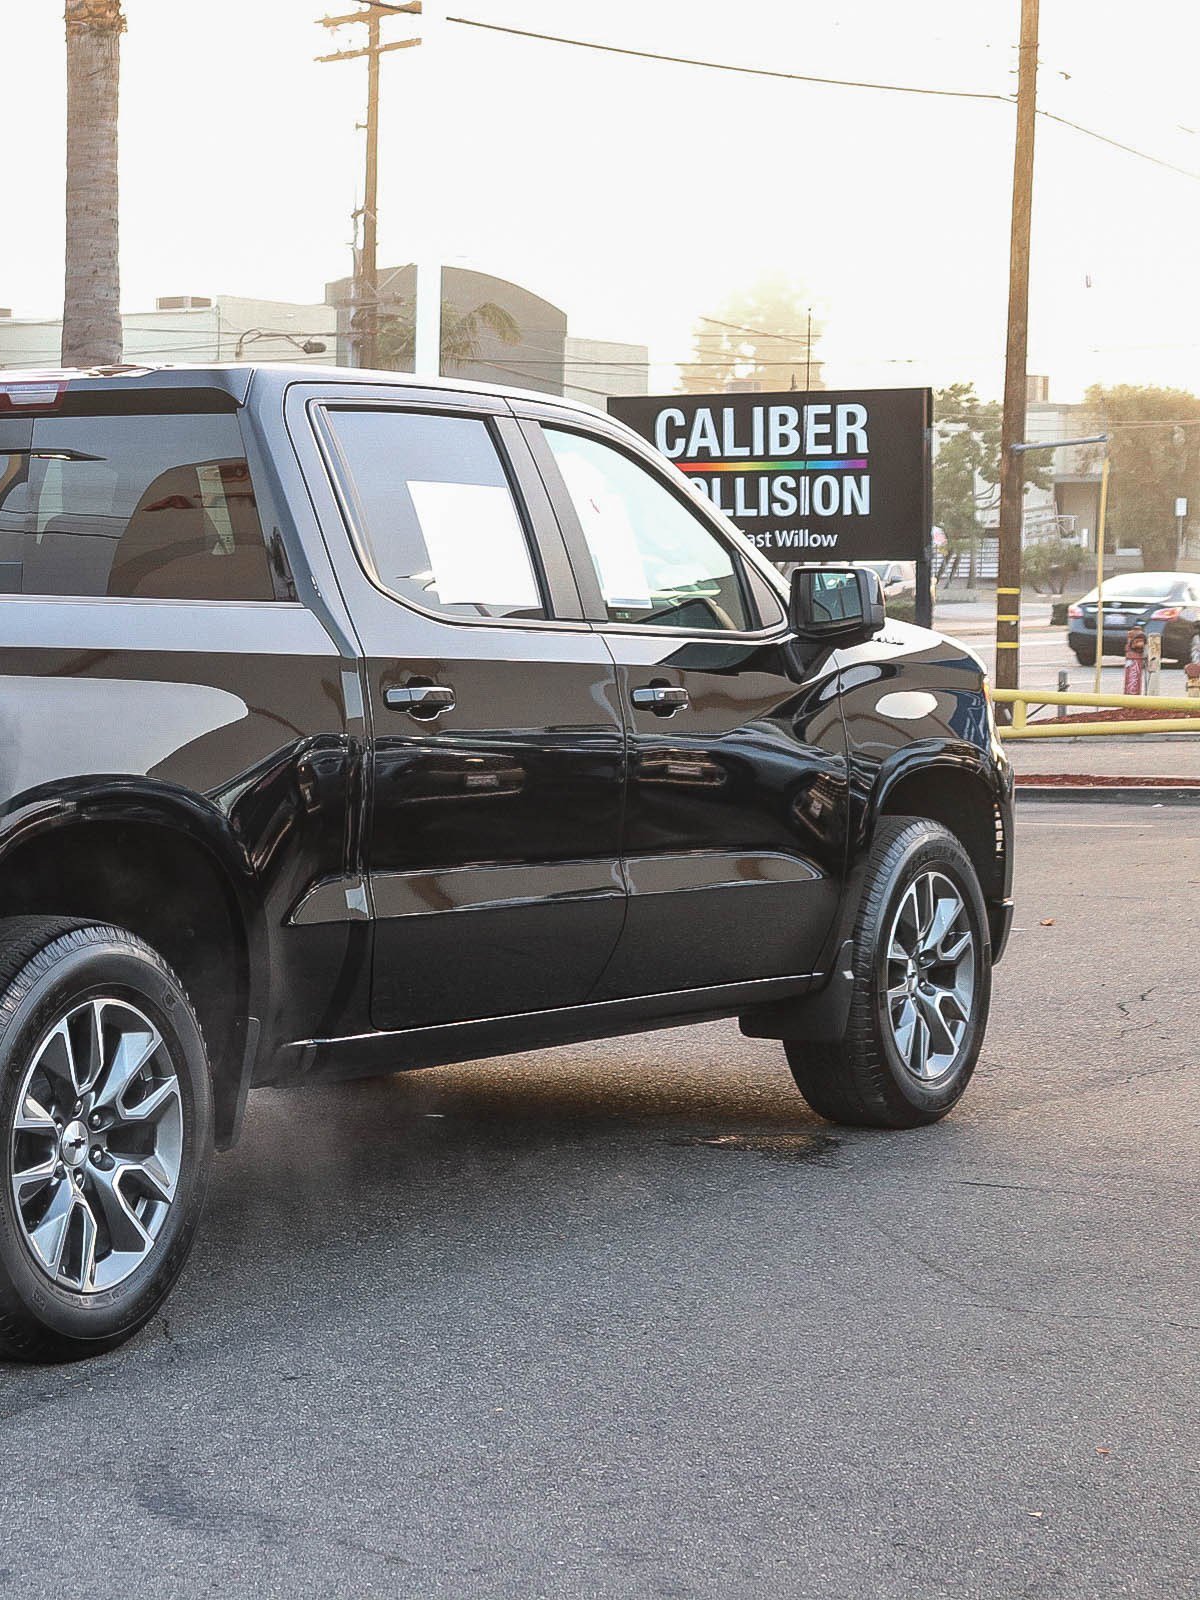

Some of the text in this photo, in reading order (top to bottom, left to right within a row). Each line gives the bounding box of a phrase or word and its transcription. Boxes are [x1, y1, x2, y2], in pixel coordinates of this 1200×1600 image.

[655, 403, 870, 459] CALIBER
[687, 474, 871, 517] LLISION
[774, 529, 838, 548] Willow
